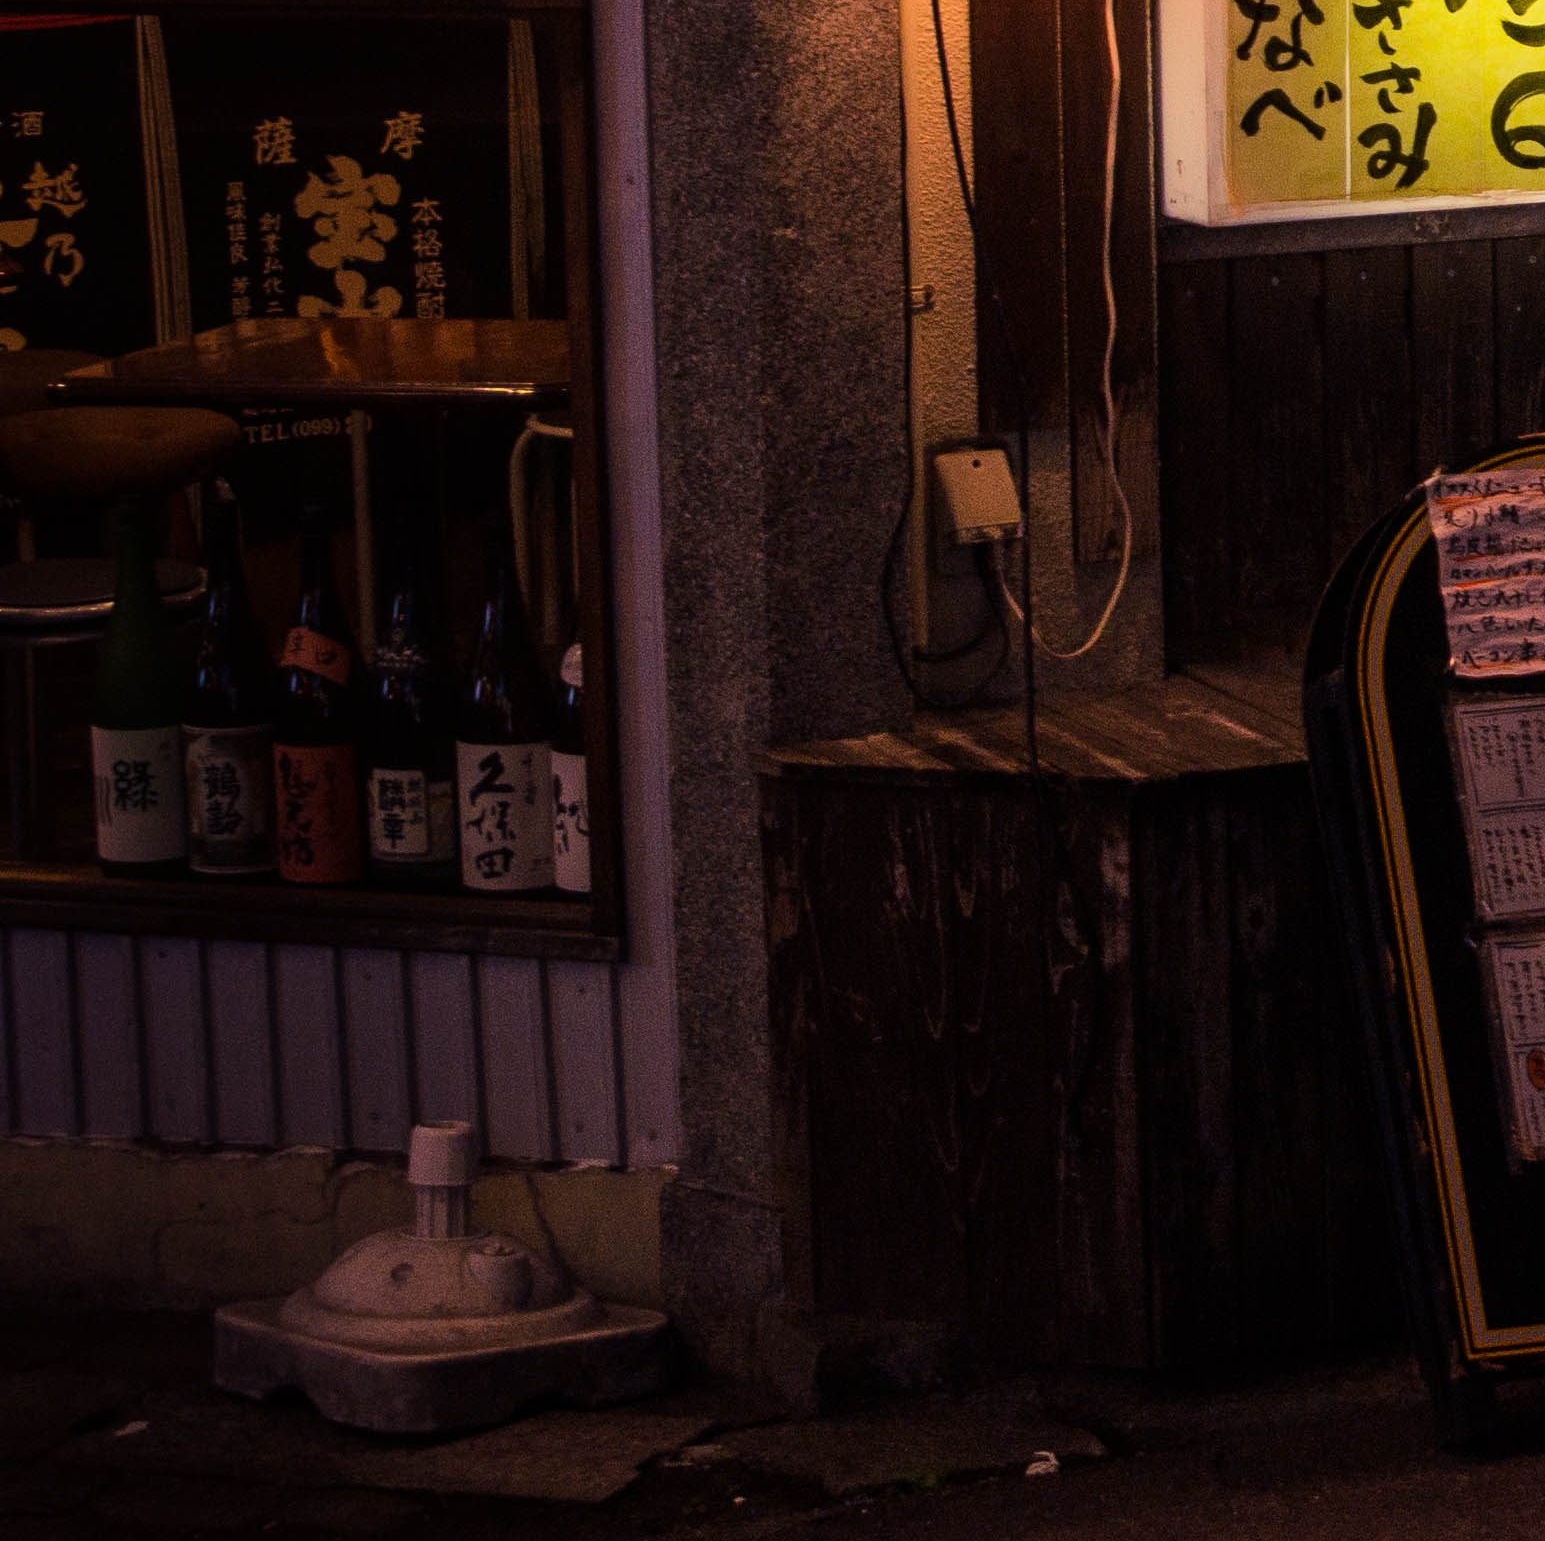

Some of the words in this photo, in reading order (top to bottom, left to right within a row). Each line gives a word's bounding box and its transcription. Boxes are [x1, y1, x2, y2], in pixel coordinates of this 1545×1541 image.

[252, 110, 425, 165] 薩摩
[411, 196, 447, 318] 本格焼酎
[465, 751, 515, 880] 久保田
